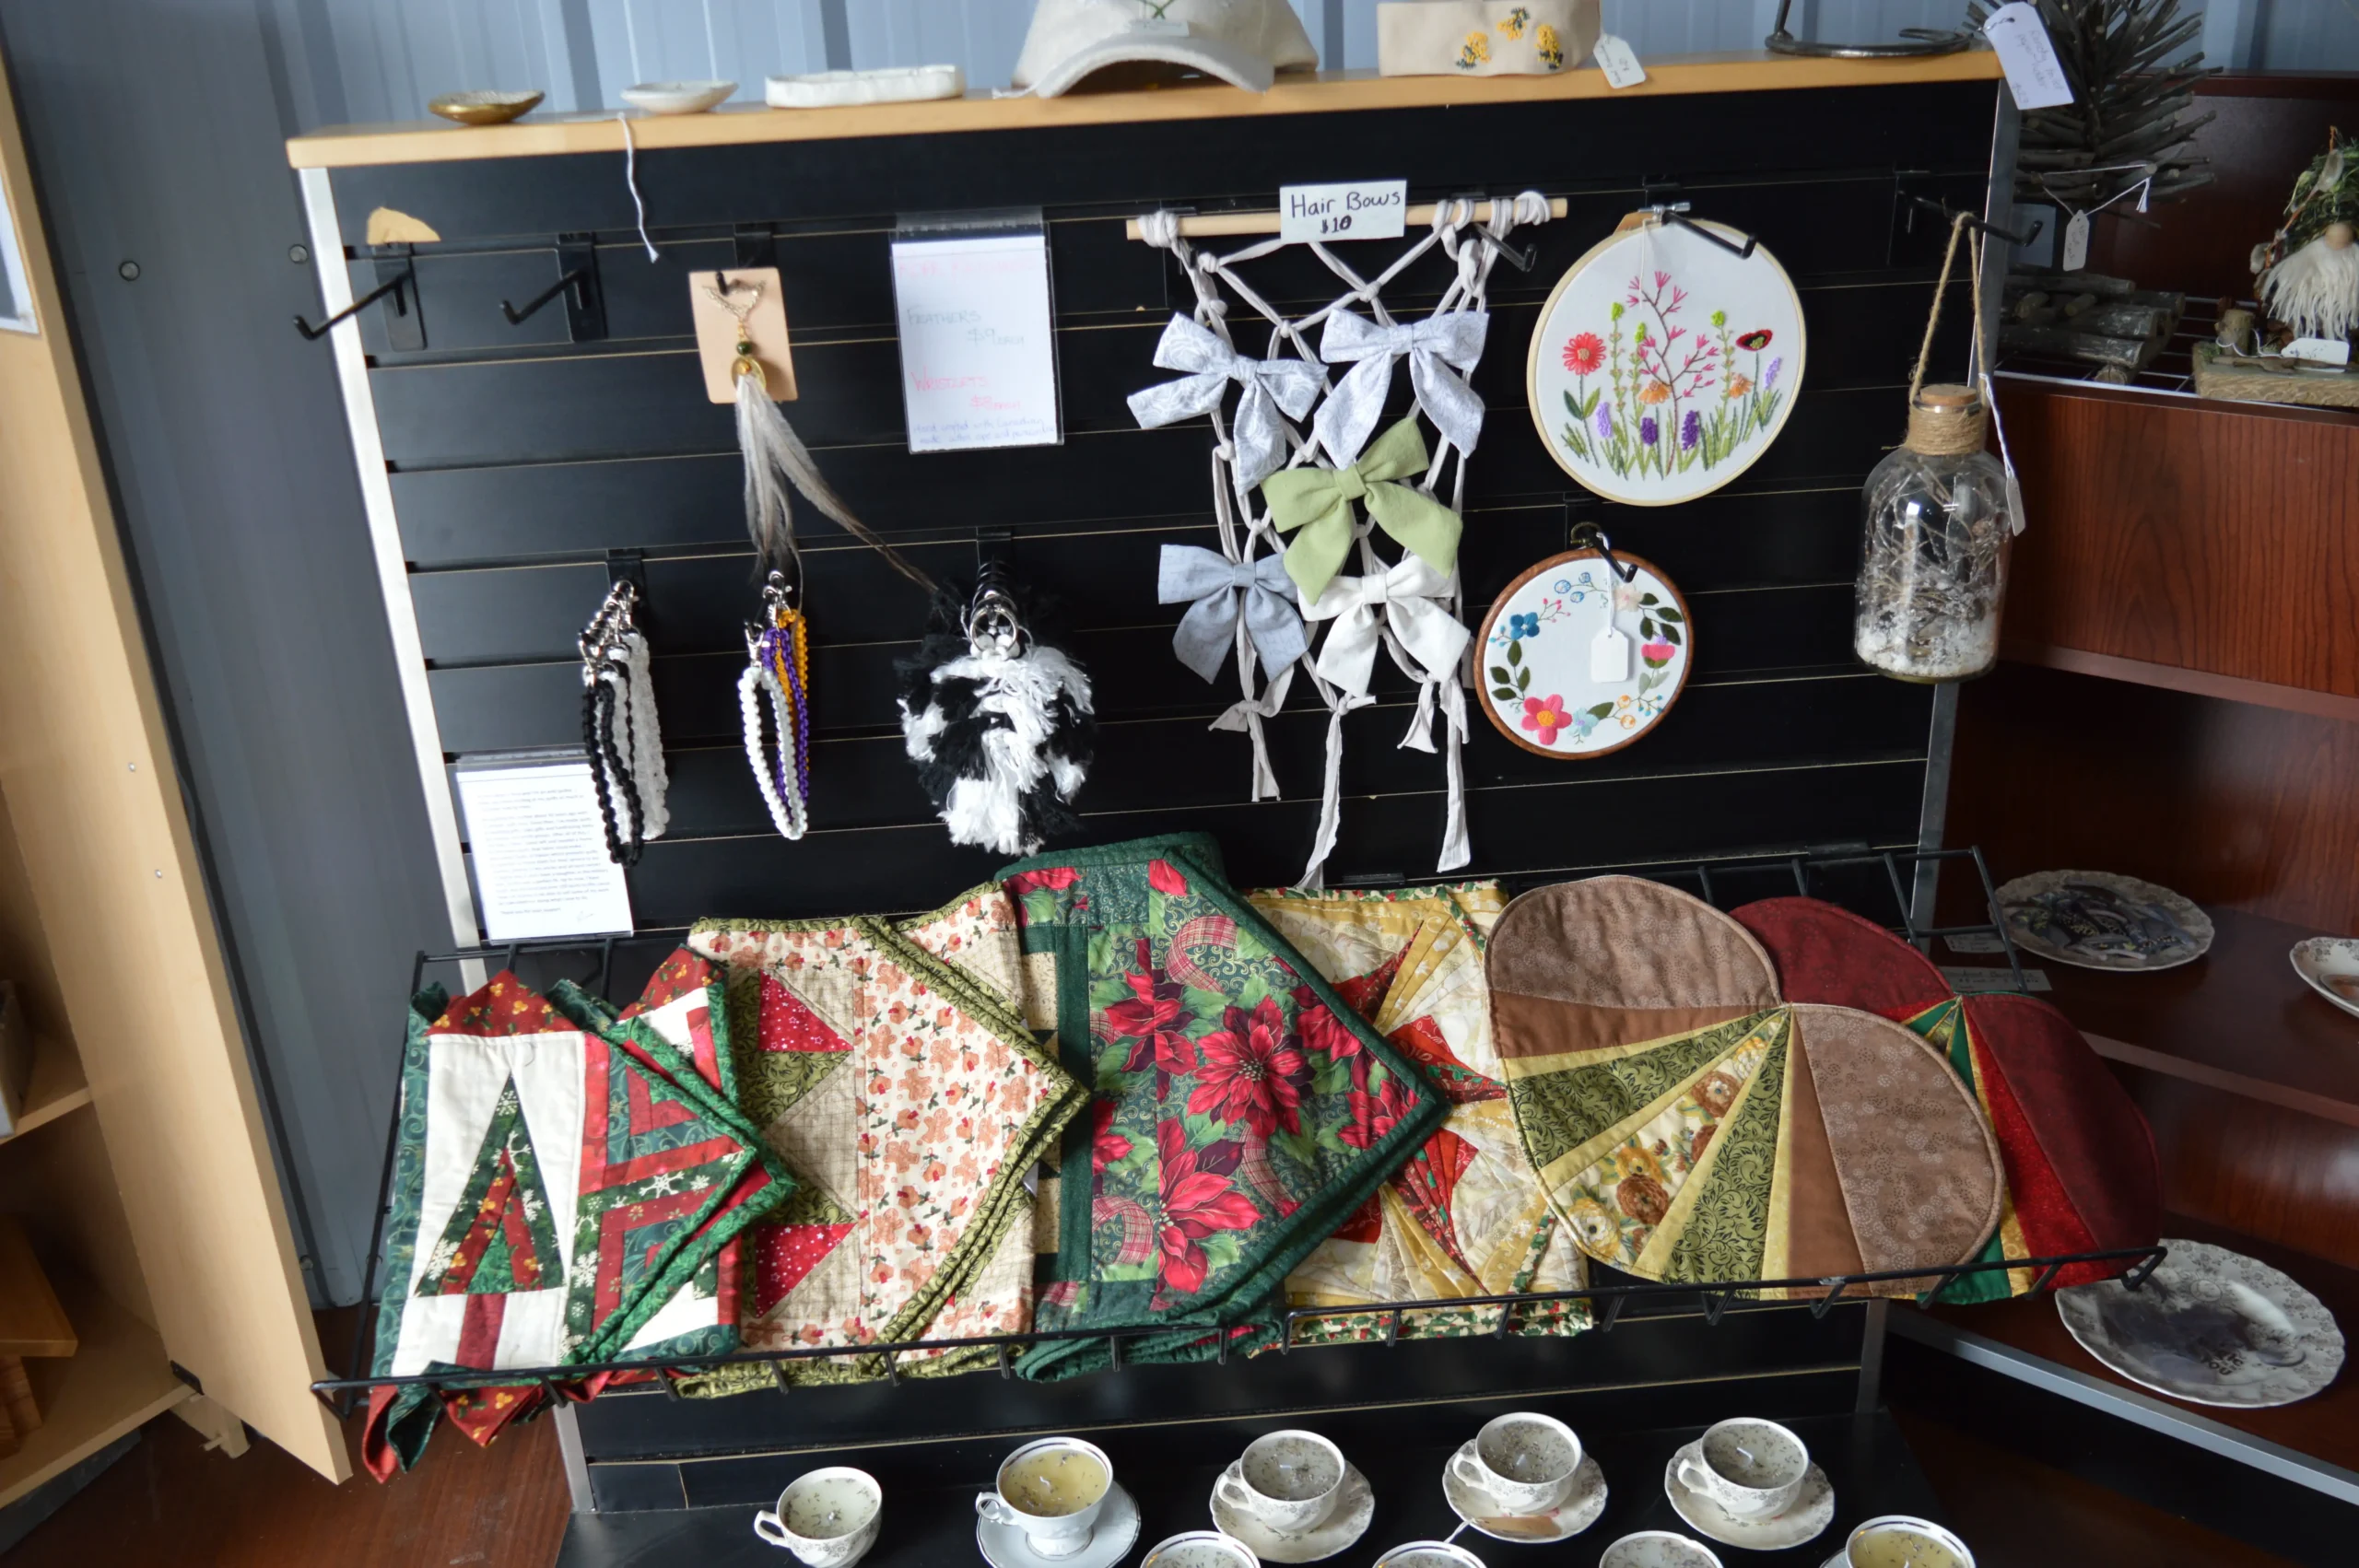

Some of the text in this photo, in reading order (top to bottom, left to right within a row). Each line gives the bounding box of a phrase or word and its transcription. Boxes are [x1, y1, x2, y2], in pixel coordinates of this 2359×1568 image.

[1291, 192, 1401, 218] Hair Bows
[1320, 215, 1352, 234] $10
